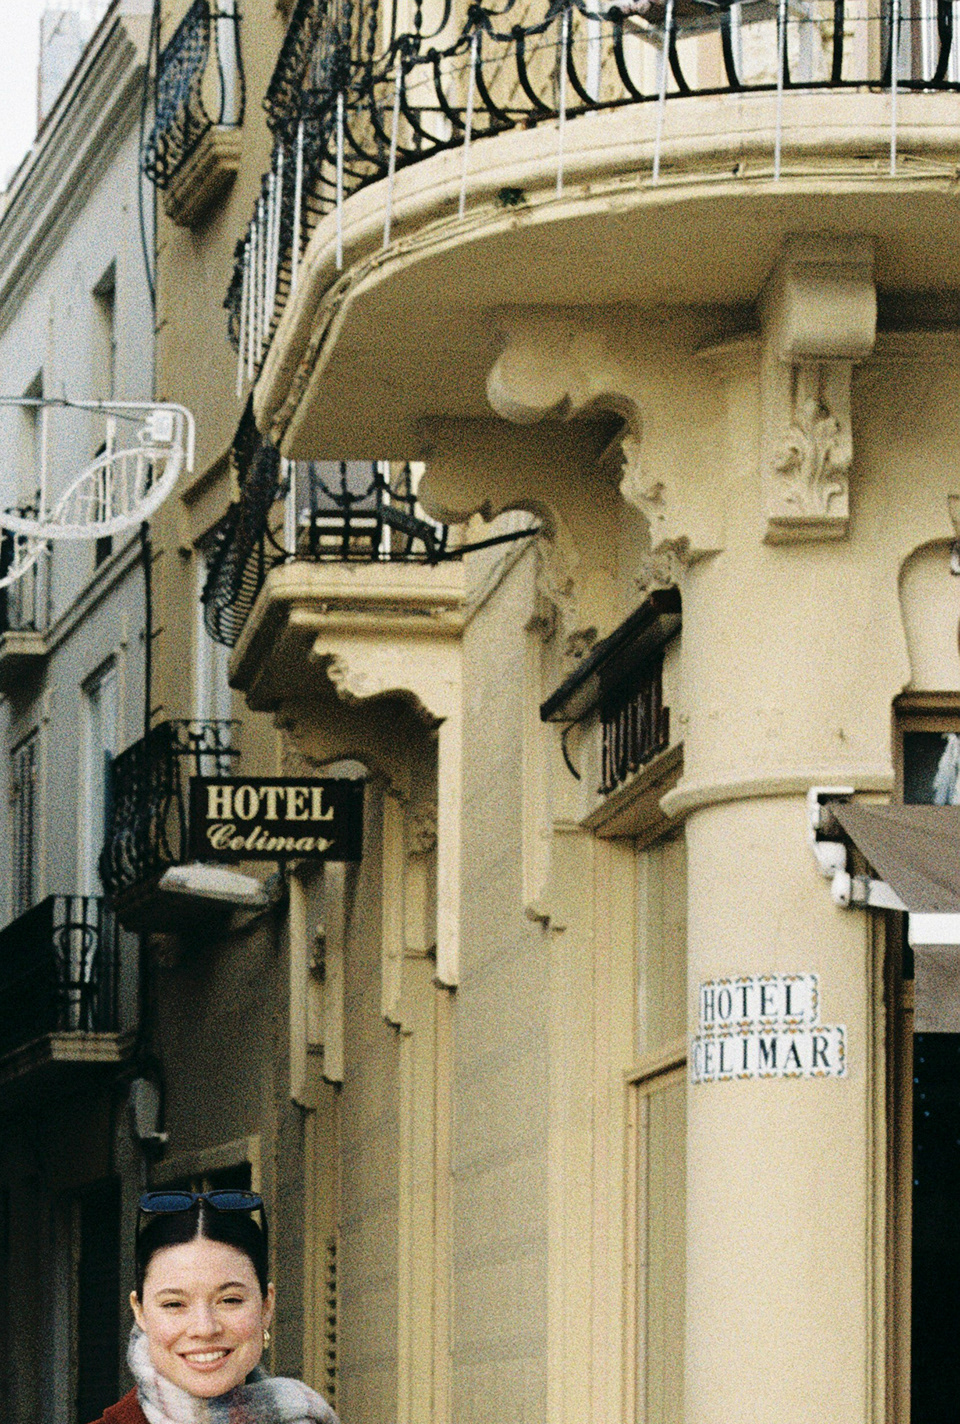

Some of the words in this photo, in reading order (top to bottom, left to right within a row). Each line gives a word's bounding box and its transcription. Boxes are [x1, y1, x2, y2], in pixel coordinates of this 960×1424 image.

[206, 785, 335, 821] HOTEL
[703, 983, 805, 1022] HOTEL
[693, 1035, 832, 1077] CELIMAR
